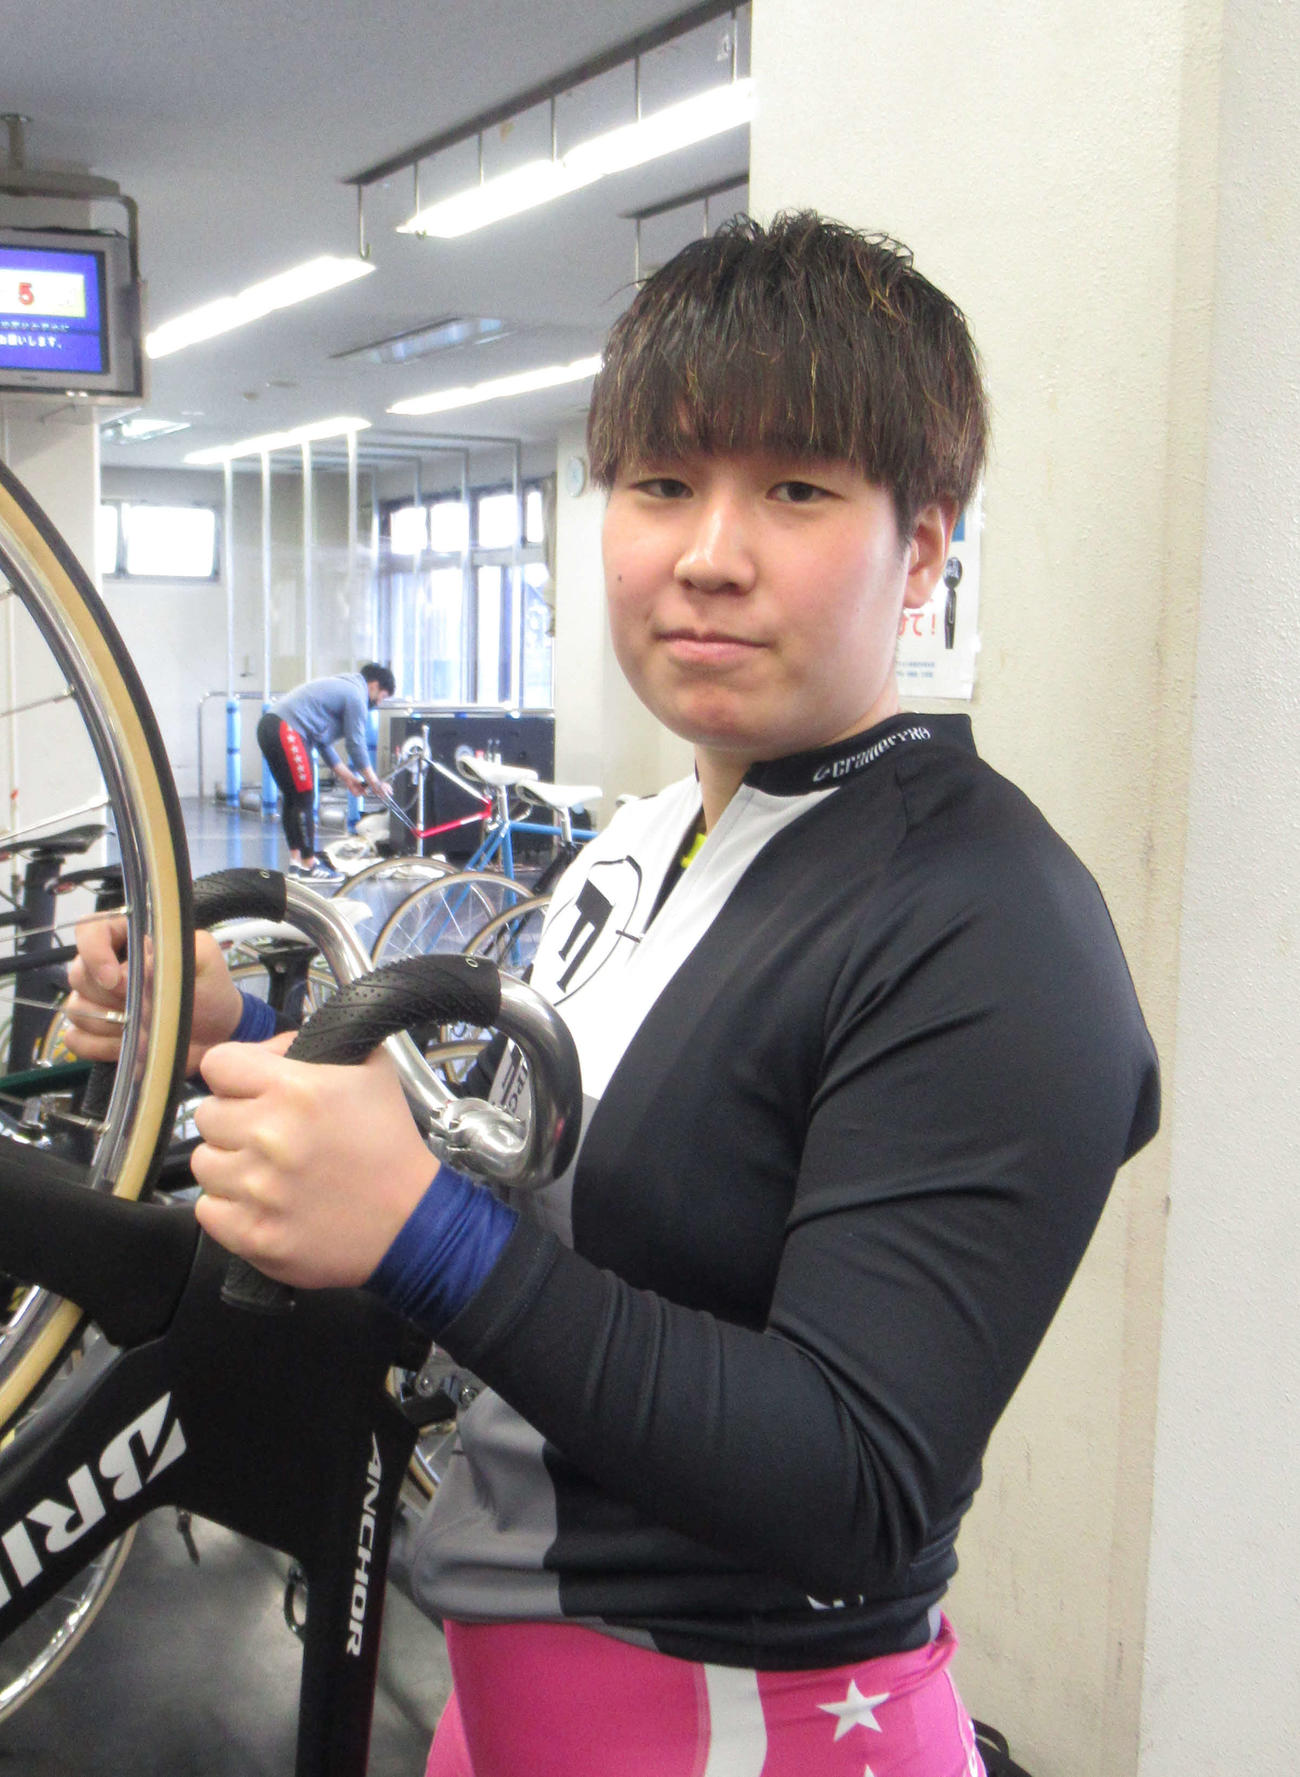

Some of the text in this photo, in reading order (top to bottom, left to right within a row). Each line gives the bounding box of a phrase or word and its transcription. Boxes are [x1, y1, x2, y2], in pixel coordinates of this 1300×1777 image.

[18, 282, 35, 306] 5
[0, 1391, 187, 1609] BRI
[346, 1431, 383, 1658] ANCHOR
